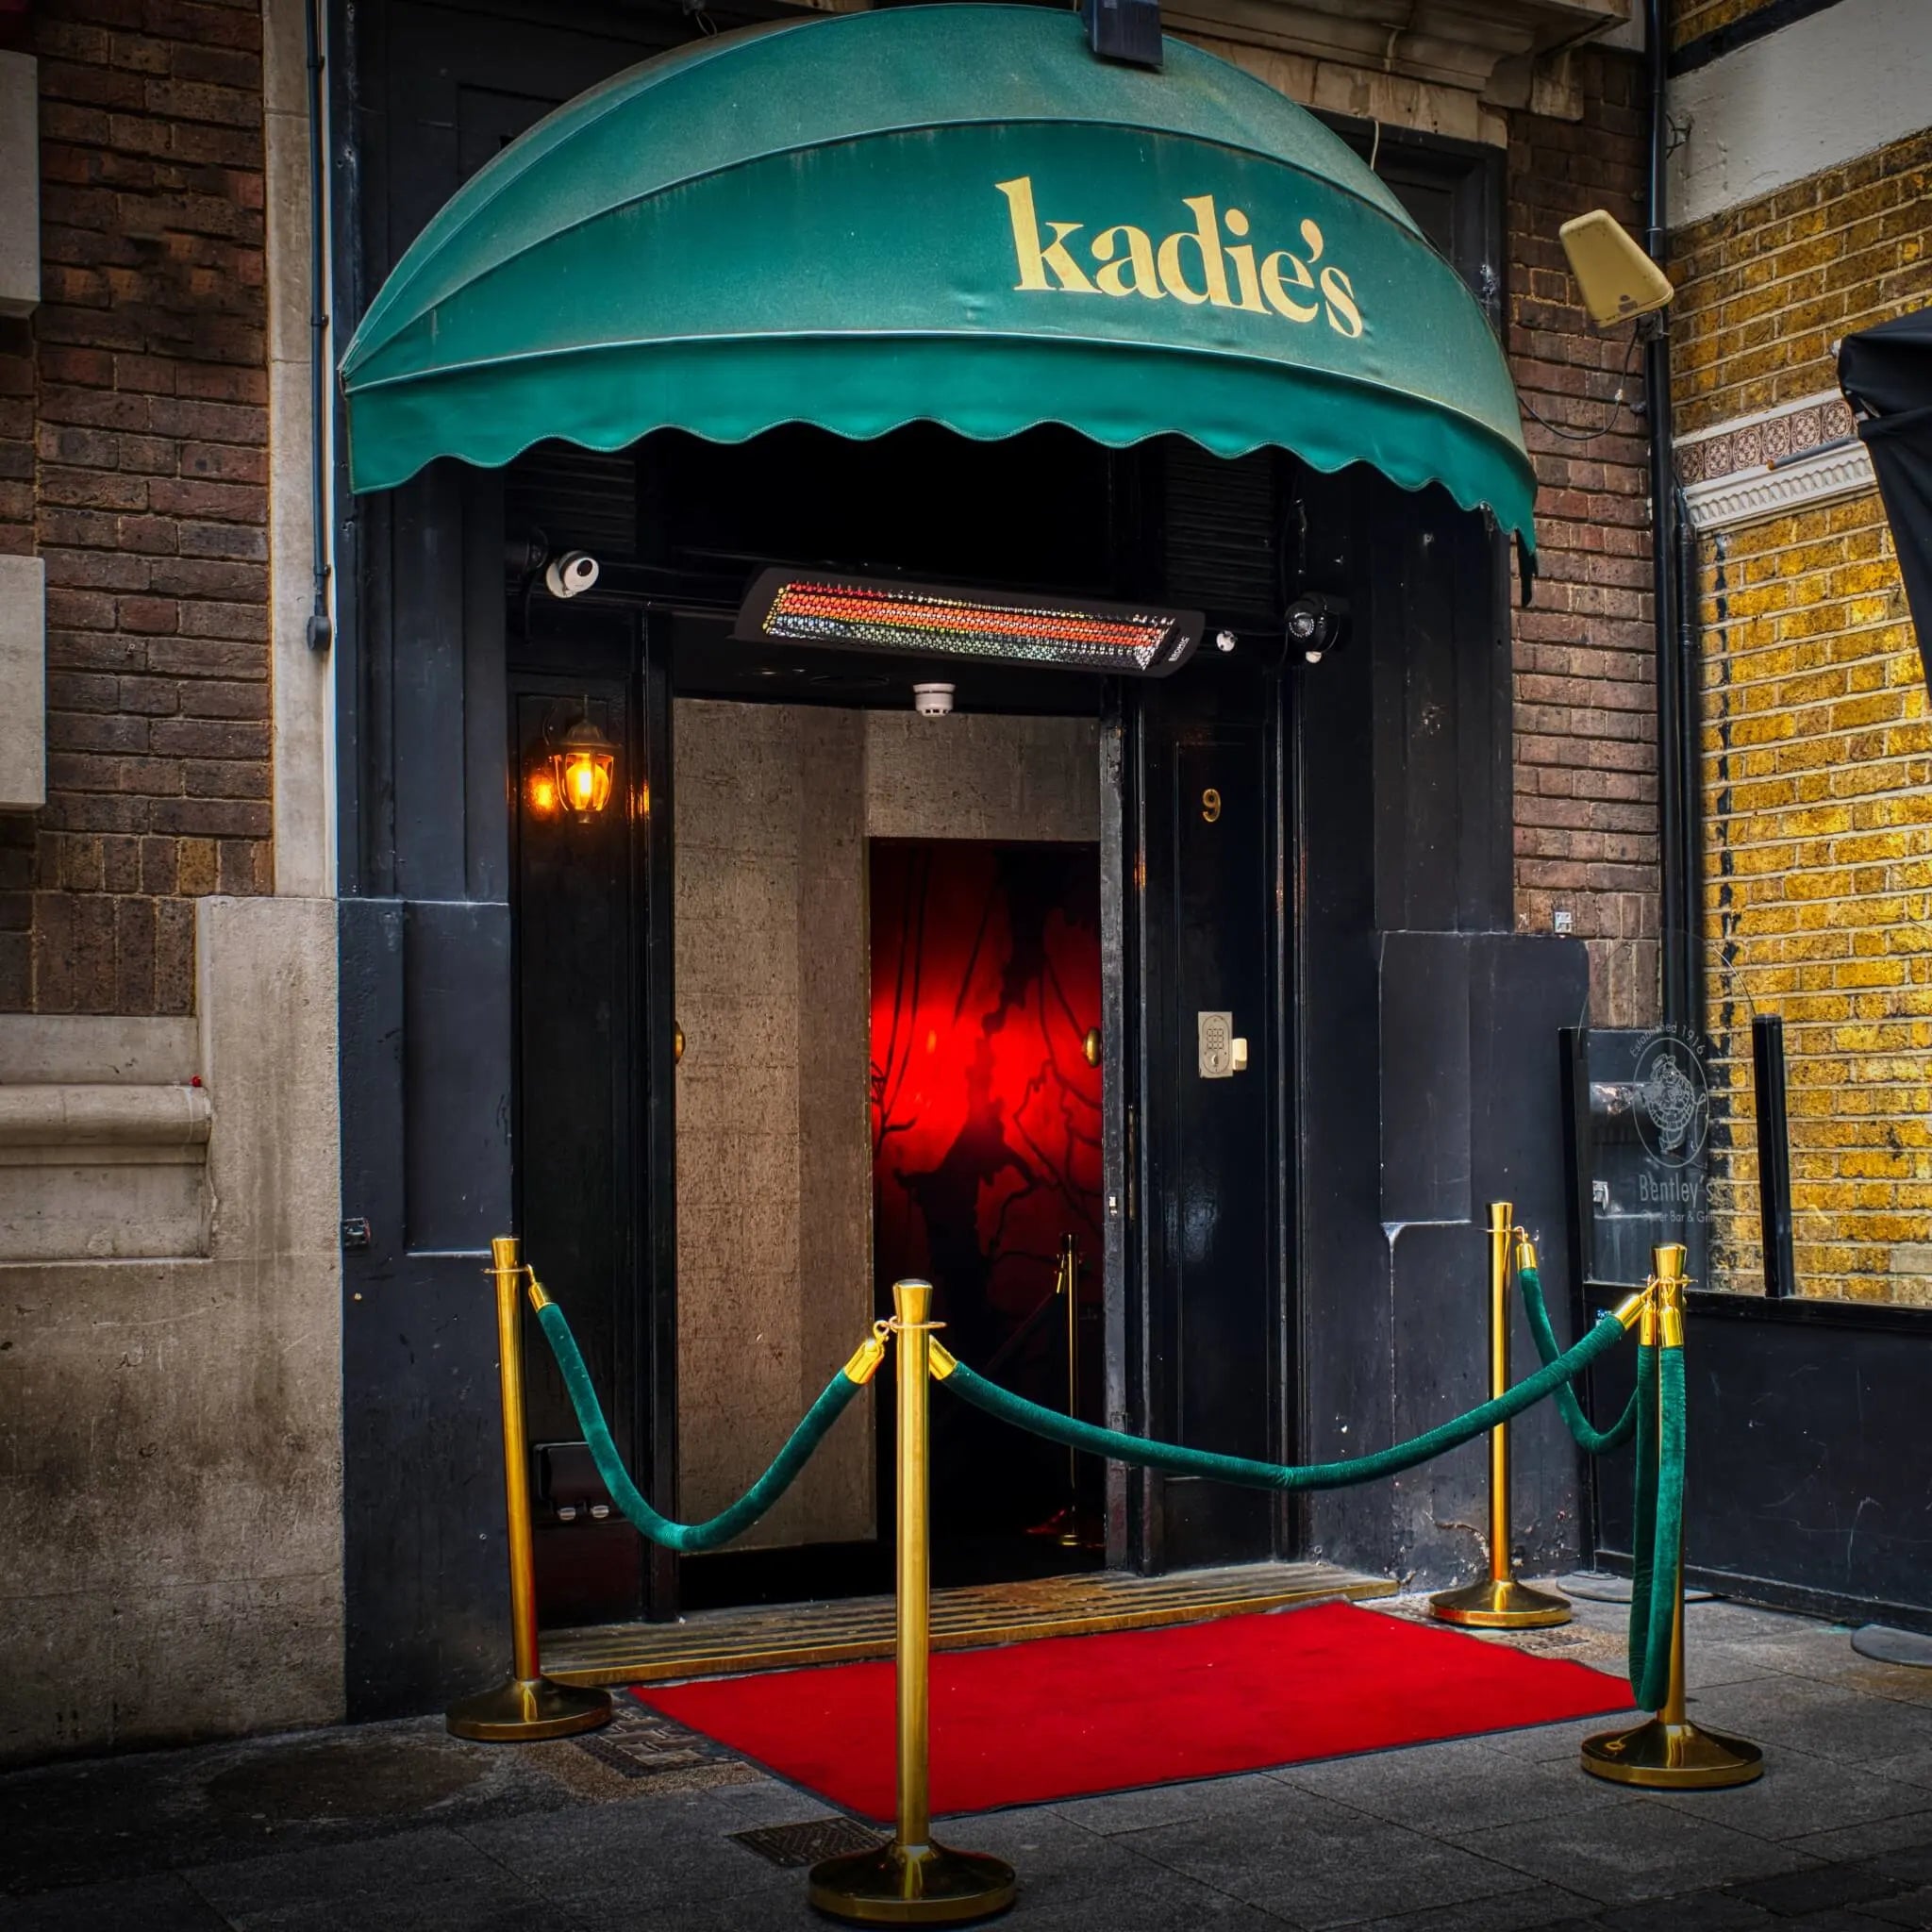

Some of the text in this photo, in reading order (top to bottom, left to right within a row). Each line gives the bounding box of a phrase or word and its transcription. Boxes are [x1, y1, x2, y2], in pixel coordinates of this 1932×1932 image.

[995, 175, 1363, 338] kadie's
[1203, 789, 1221, 822] 9
[1682, 1024, 1706, 1055] 1916
[1640, 1173, 1713, 1208] Bentley's
[1670, 1210, 1685, 1222] Bar
[1687, 1210, 1694, 1222] &
